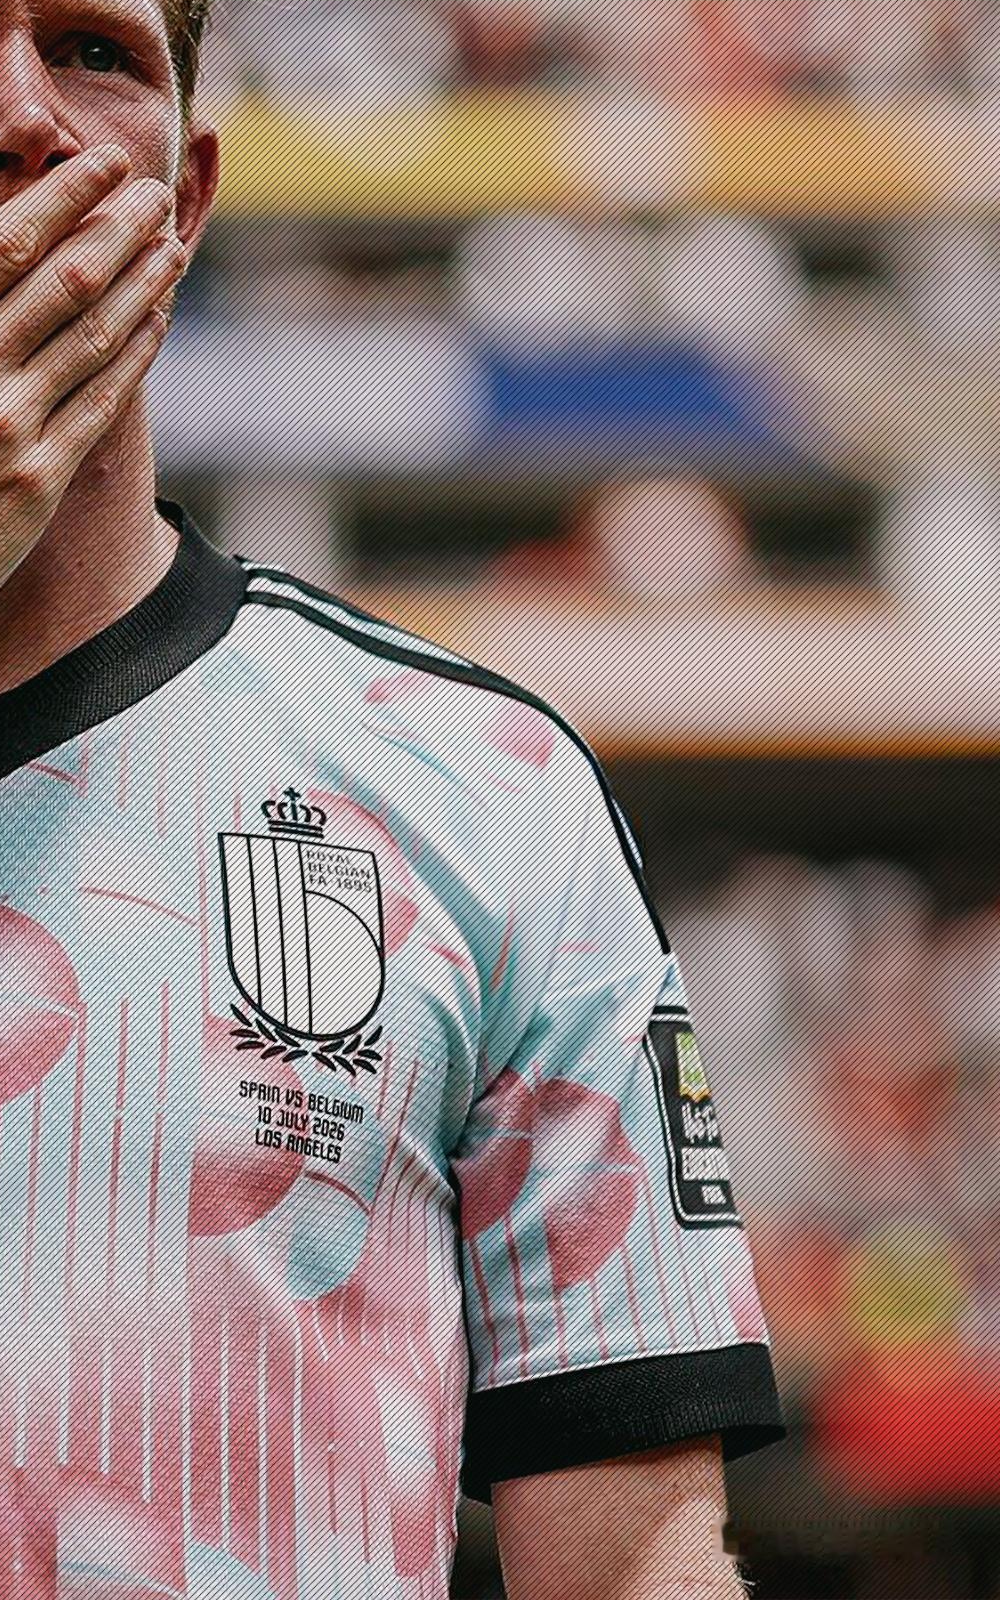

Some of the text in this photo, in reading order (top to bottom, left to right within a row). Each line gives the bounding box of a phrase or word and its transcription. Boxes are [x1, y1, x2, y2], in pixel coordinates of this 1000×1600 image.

[306, 850, 351, 865] ROYAL
[308, 862, 371, 880] BELGIAN
[239, 1080, 365, 1124] SPAIN VS BELGIUM
[257, 1105, 346, 1142] 10 JULY 2026
[254, 1128, 343, 1164] LOS ANGELES
